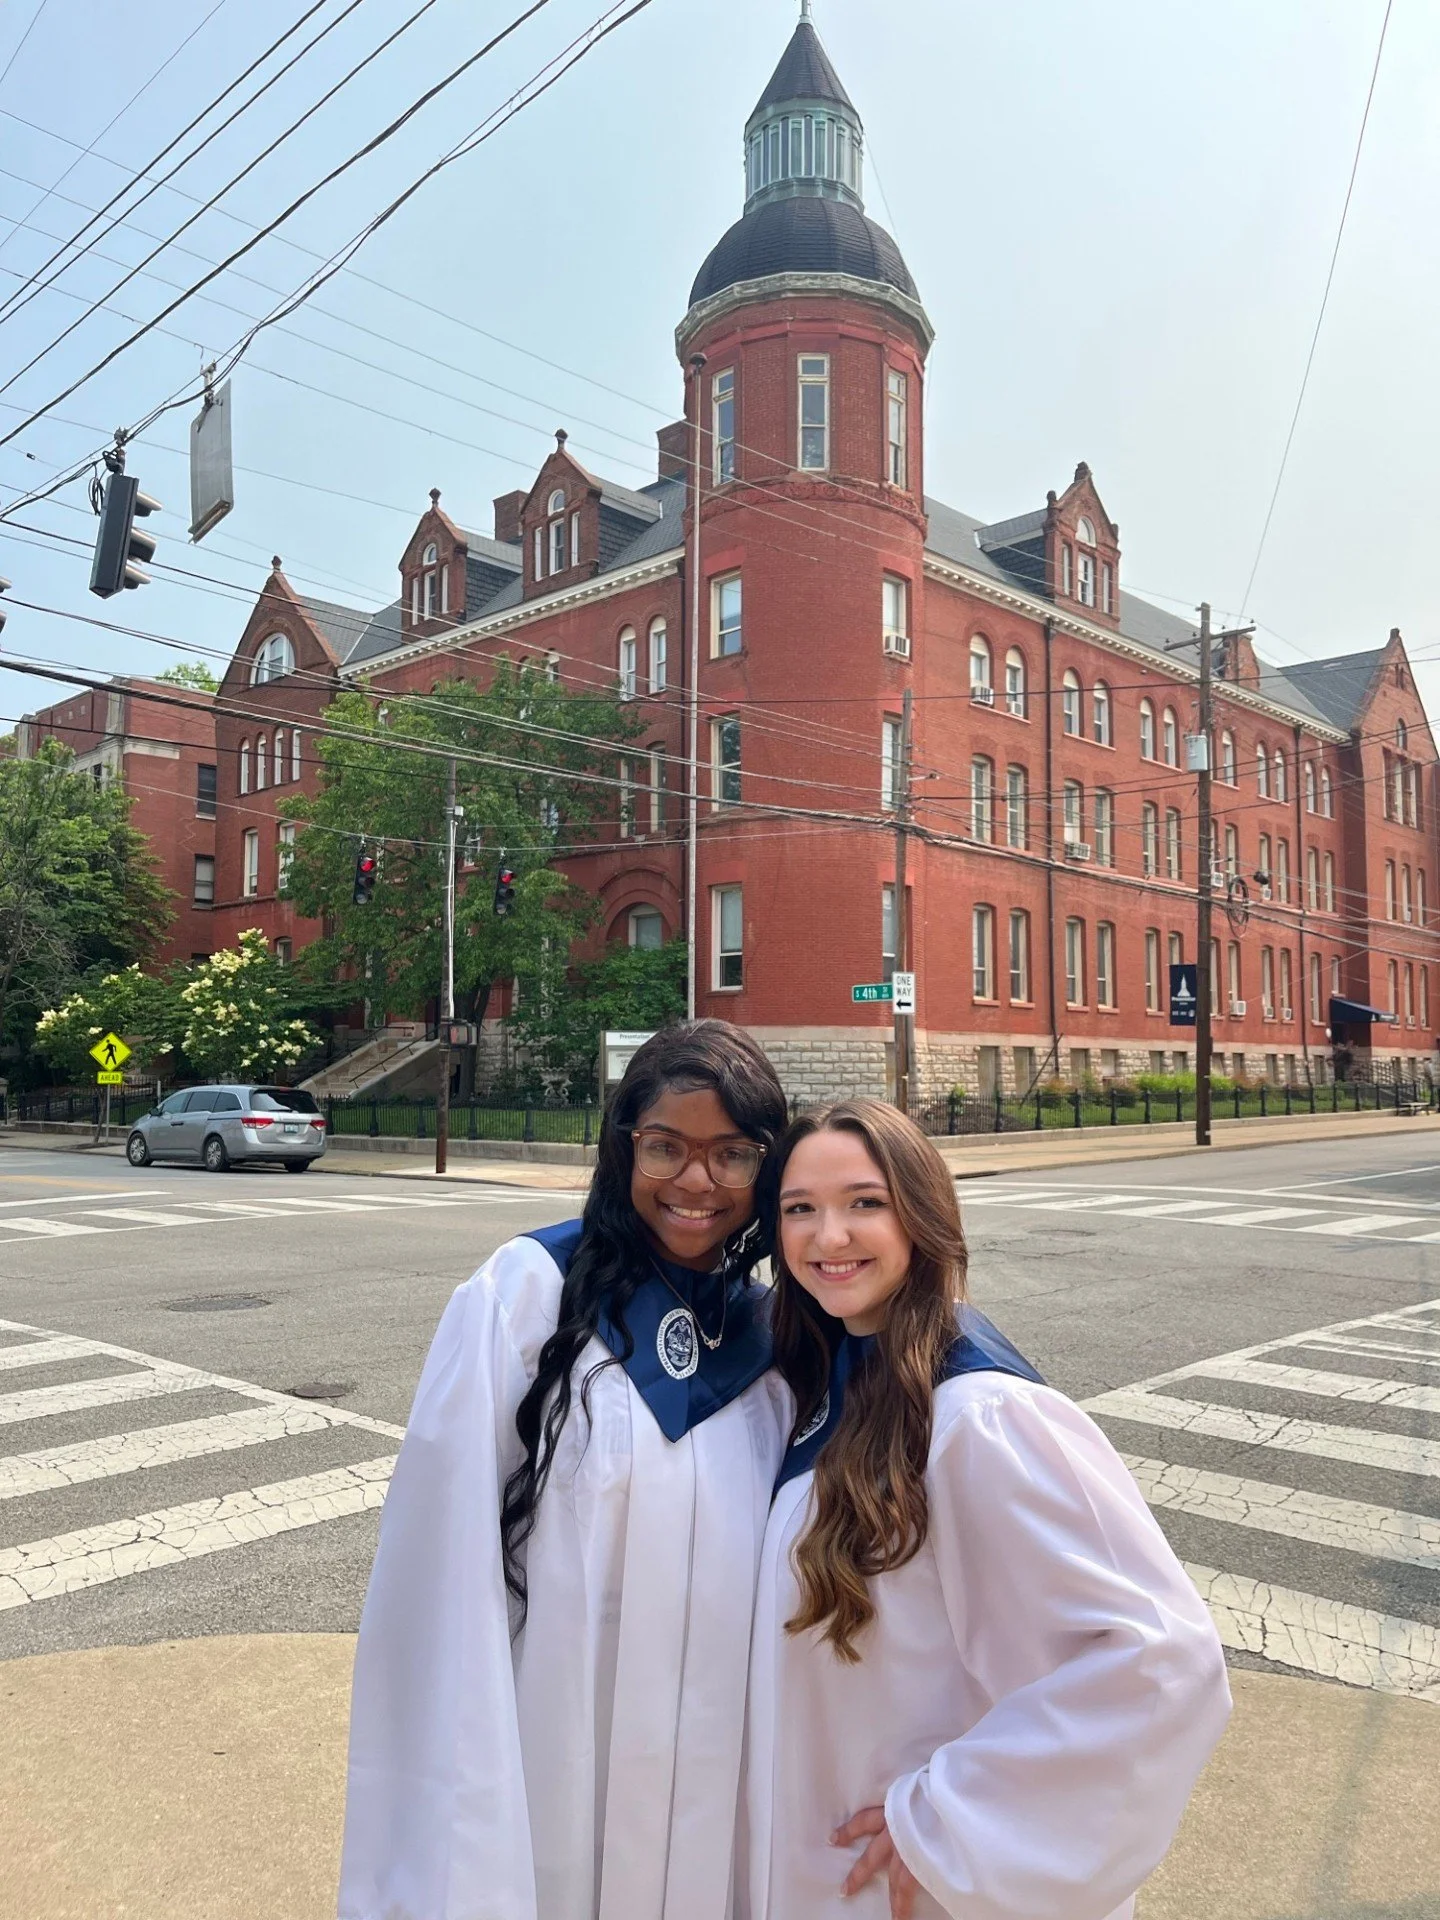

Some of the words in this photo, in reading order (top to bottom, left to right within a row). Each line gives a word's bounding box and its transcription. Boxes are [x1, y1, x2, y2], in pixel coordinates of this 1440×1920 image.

[896, 976, 911, 985] ONE
[862, 987, 878, 999] 4th
[896, 987, 911, 996] WAY
